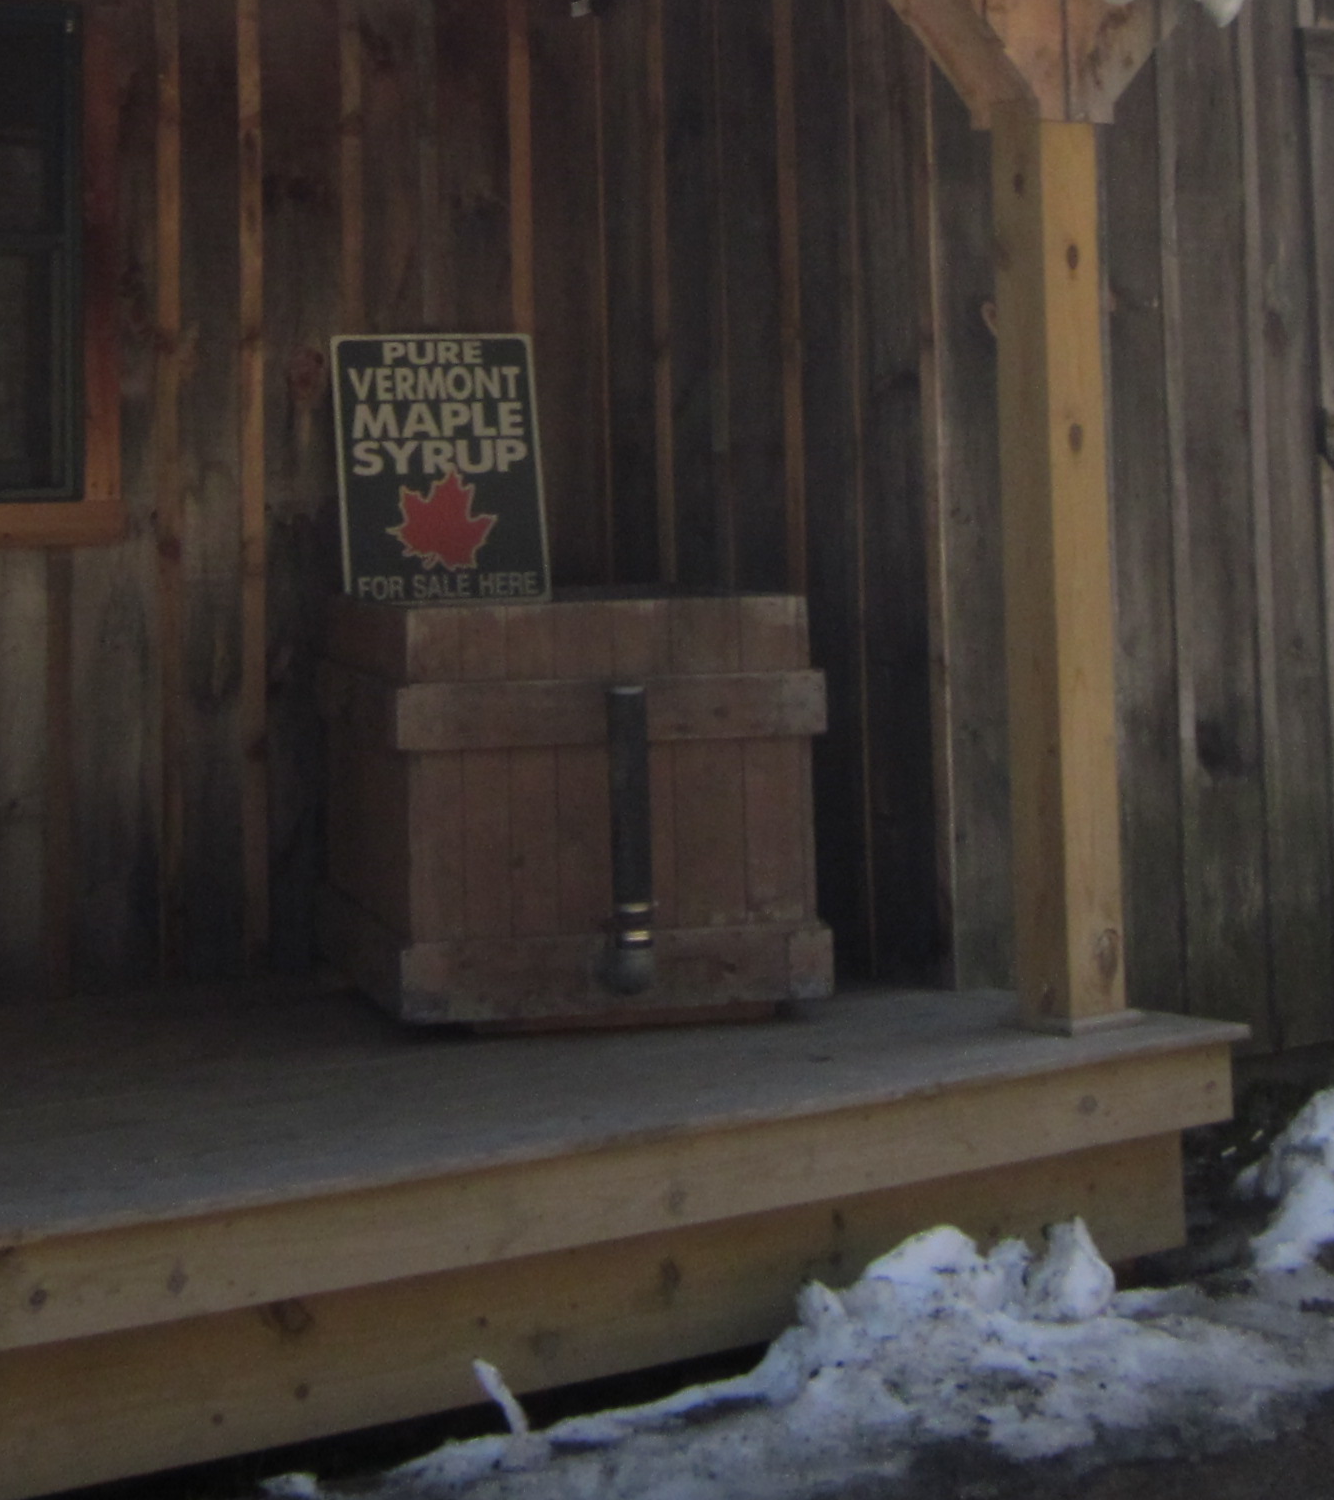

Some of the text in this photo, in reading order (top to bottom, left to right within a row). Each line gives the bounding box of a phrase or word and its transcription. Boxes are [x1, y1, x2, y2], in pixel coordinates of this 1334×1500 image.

[382, 341, 483, 366] PURE
[347, 366, 521, 401] VERMONT
[352, 402, 525, 439] MAPLE
[352, 439, 528, 477] SYRUP
[357, 571, 539, 600] FOR SALE HERE
